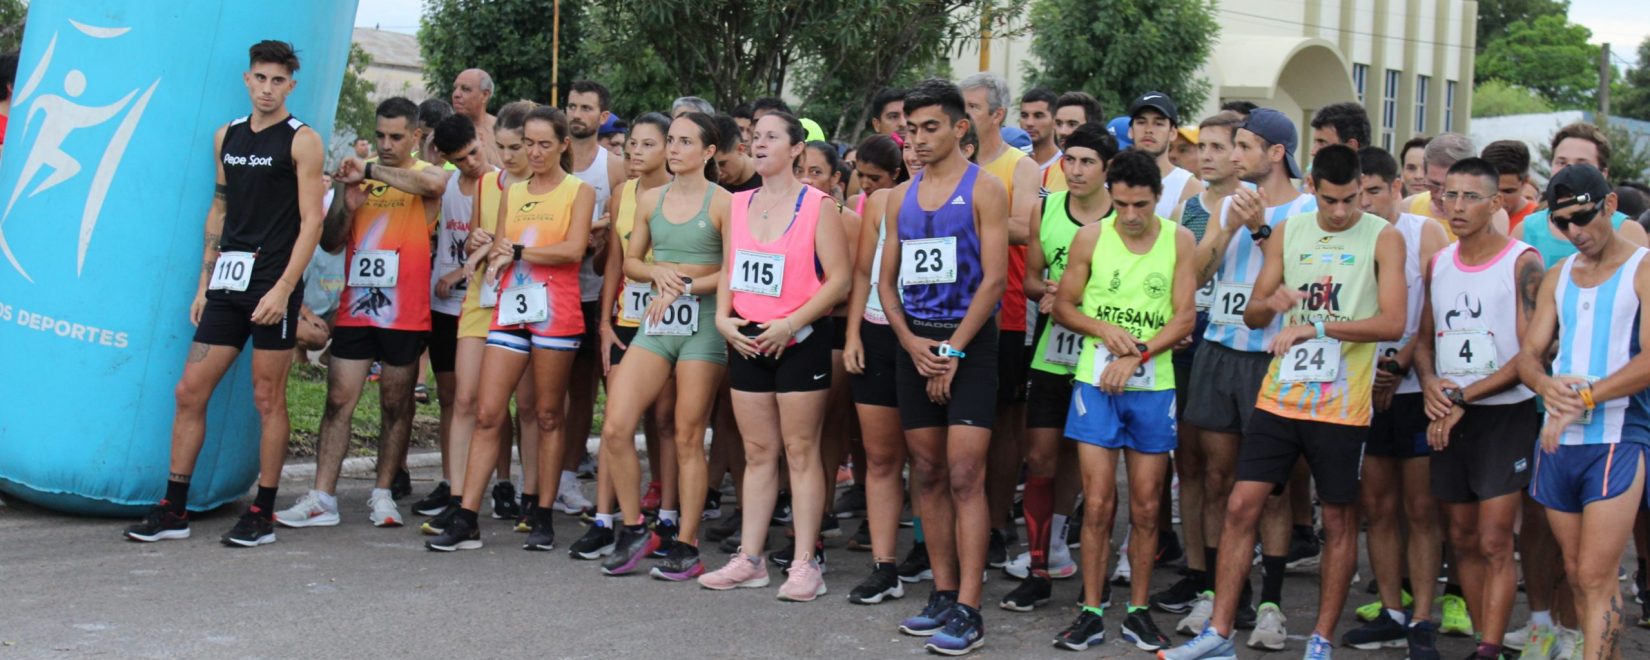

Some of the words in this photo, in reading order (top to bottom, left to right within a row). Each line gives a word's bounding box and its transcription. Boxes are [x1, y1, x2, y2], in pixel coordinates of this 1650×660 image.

[224, 153, 247, 166] Pepe
[248, 155, 273, 167] Sport
[218, 260, 245, 281] 110
[359, 257, 386, 278] 28
[914, 248, 943, 273] 23
[742, 260, 774, 286] 115
[516, 293, 528, 314] 3
[661, 303, 693, 326] 00
[16, 308, 129, 348] DEPORTES
[1293, 347, 1326, 371] 24
[1459, 339, 1473, 363] 4
